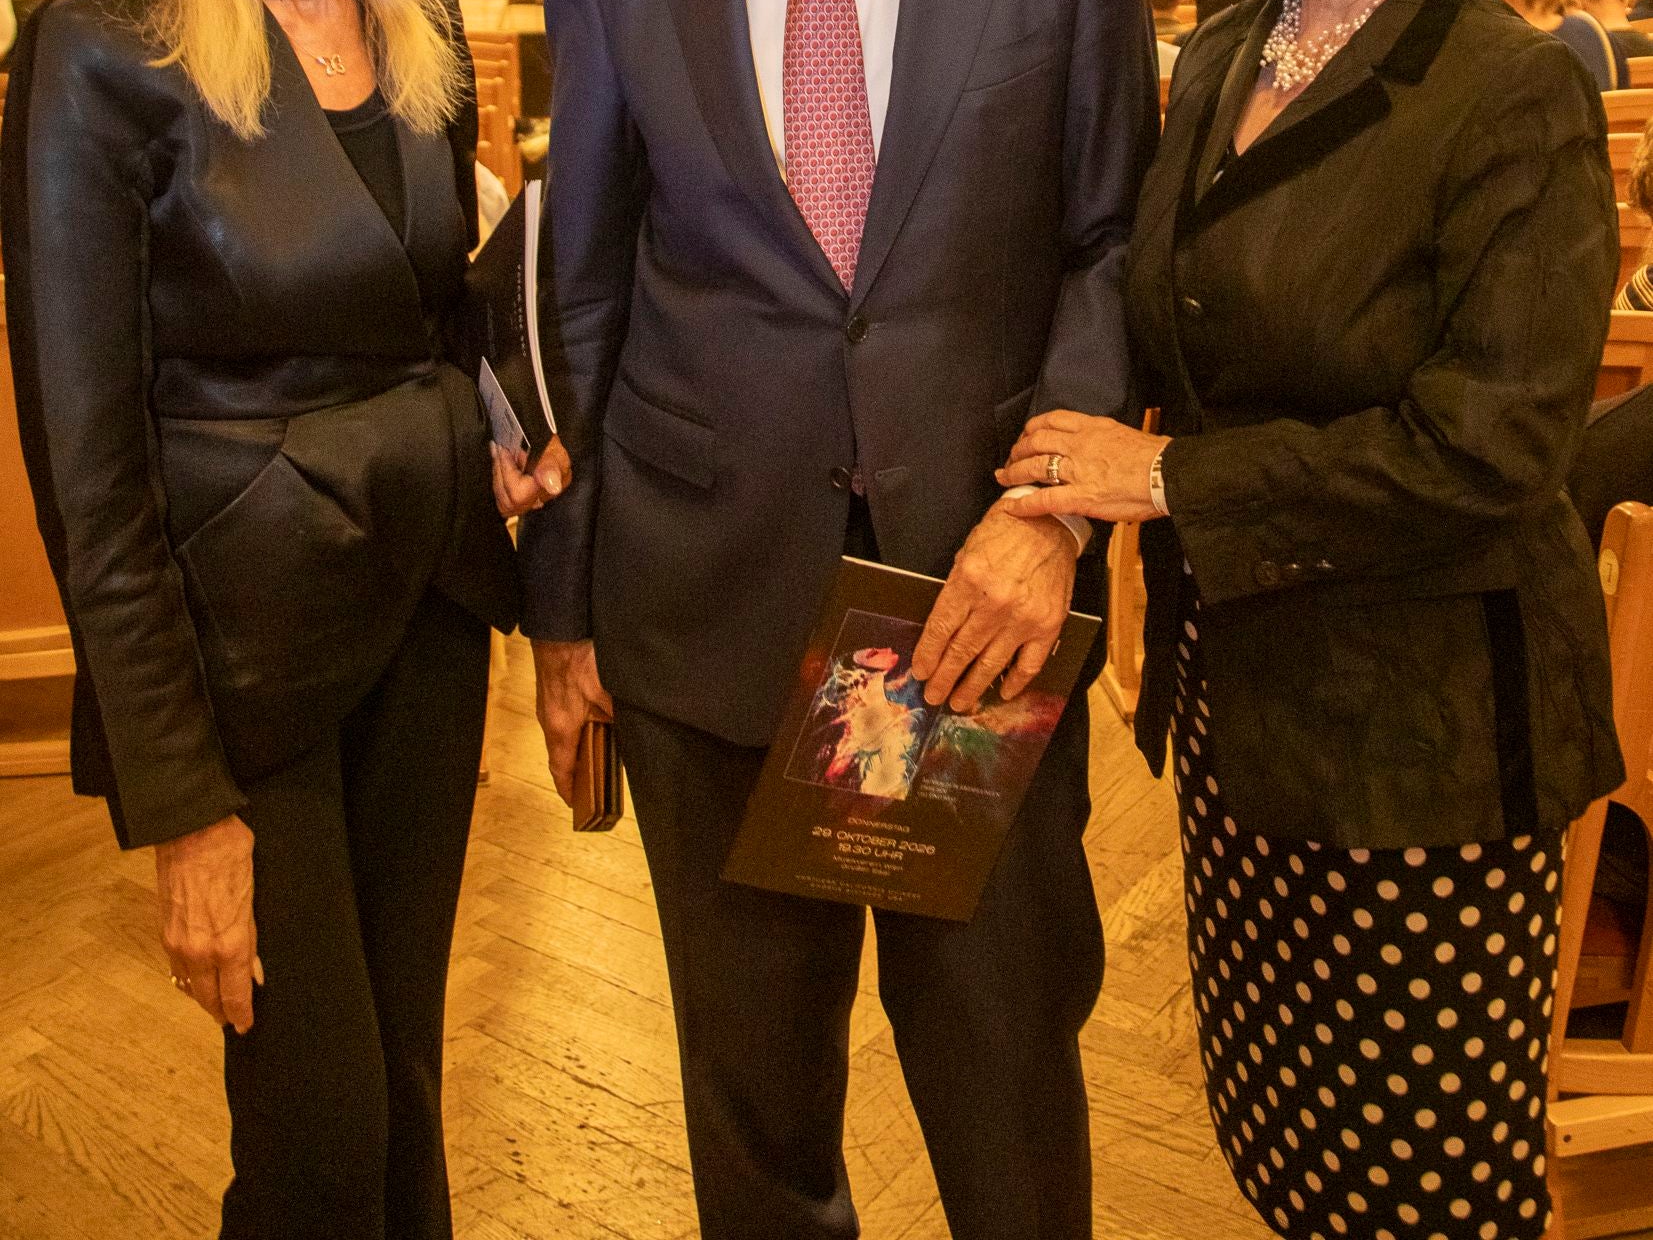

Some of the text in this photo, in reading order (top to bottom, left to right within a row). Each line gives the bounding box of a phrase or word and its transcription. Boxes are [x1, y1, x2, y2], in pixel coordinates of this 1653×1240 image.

[847, 816, 911, 833] DONNERSTAG
[836, 830, 897, 848] OKTOBER
[898, 840, 936, 856] 2026
[874, 848, 904, 861] UHR
